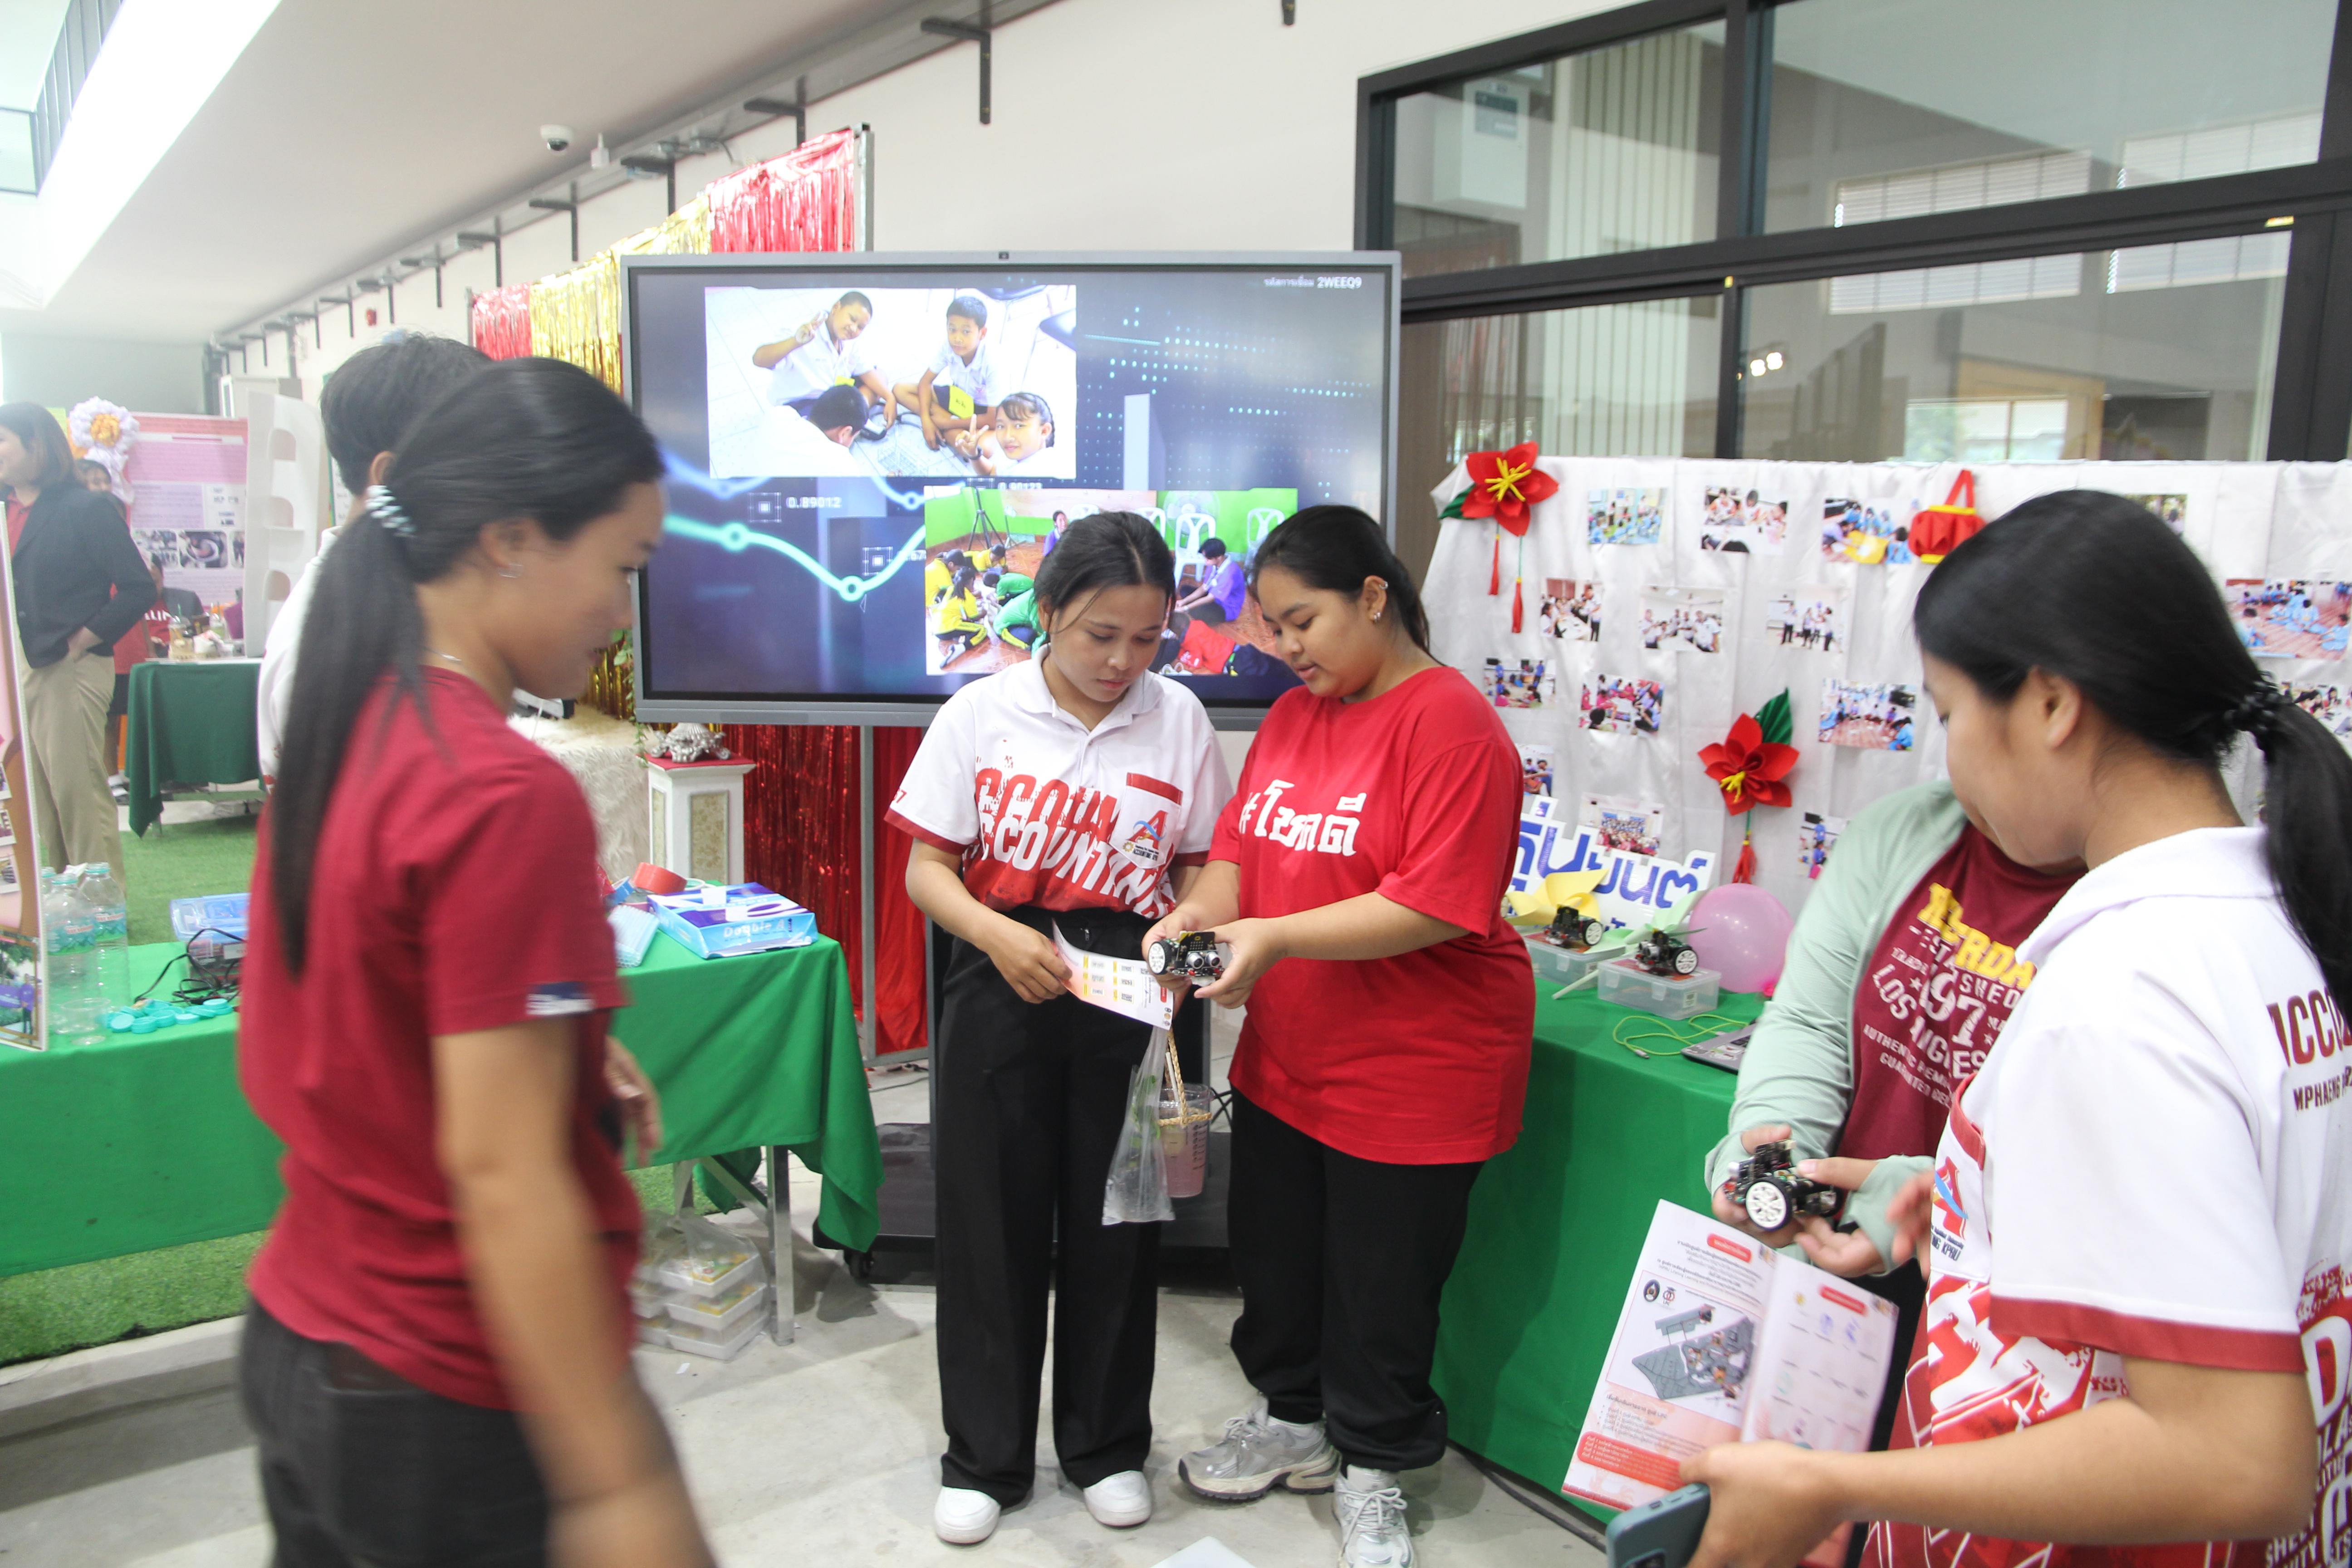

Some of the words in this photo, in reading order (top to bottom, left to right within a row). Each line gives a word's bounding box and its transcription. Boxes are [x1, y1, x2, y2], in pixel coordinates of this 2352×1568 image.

[1317, 276, 1362, 289] 2WEEQ9
[786, 496, 843, 509] 0.89012
[1872, 963, 1917, 1020] LOS
